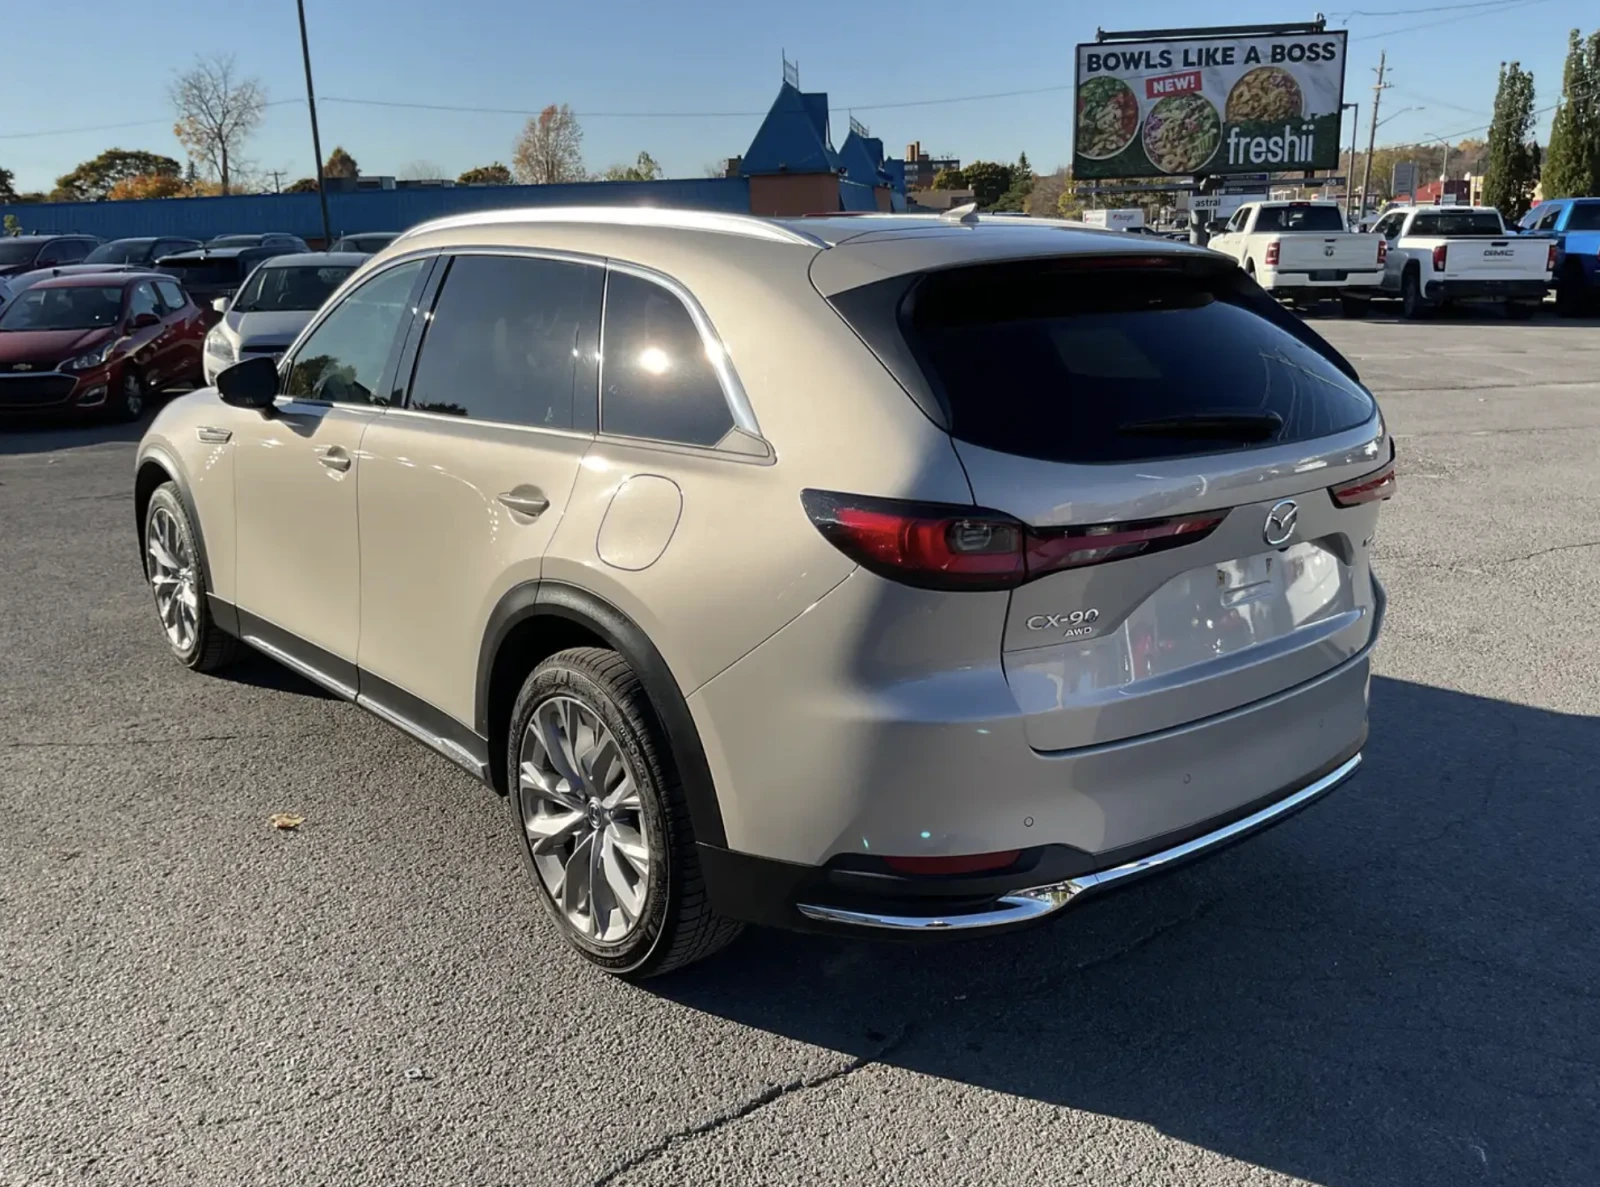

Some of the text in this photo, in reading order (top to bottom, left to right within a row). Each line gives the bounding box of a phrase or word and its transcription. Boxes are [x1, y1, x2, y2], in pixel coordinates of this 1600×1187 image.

[1087, 42, 1336, 72] BOWLS LIKE A BOSS
[1153, 76, 1196, 94] NEW!
[1227, 125, 1315, 165] freshii
[1195, 198, 1221, 208] astral
[1483, 249, 1515, 257] GMC
[1026, 608, 1099, 631] CX-90
[1064, 626, 1093, 637] AWD
